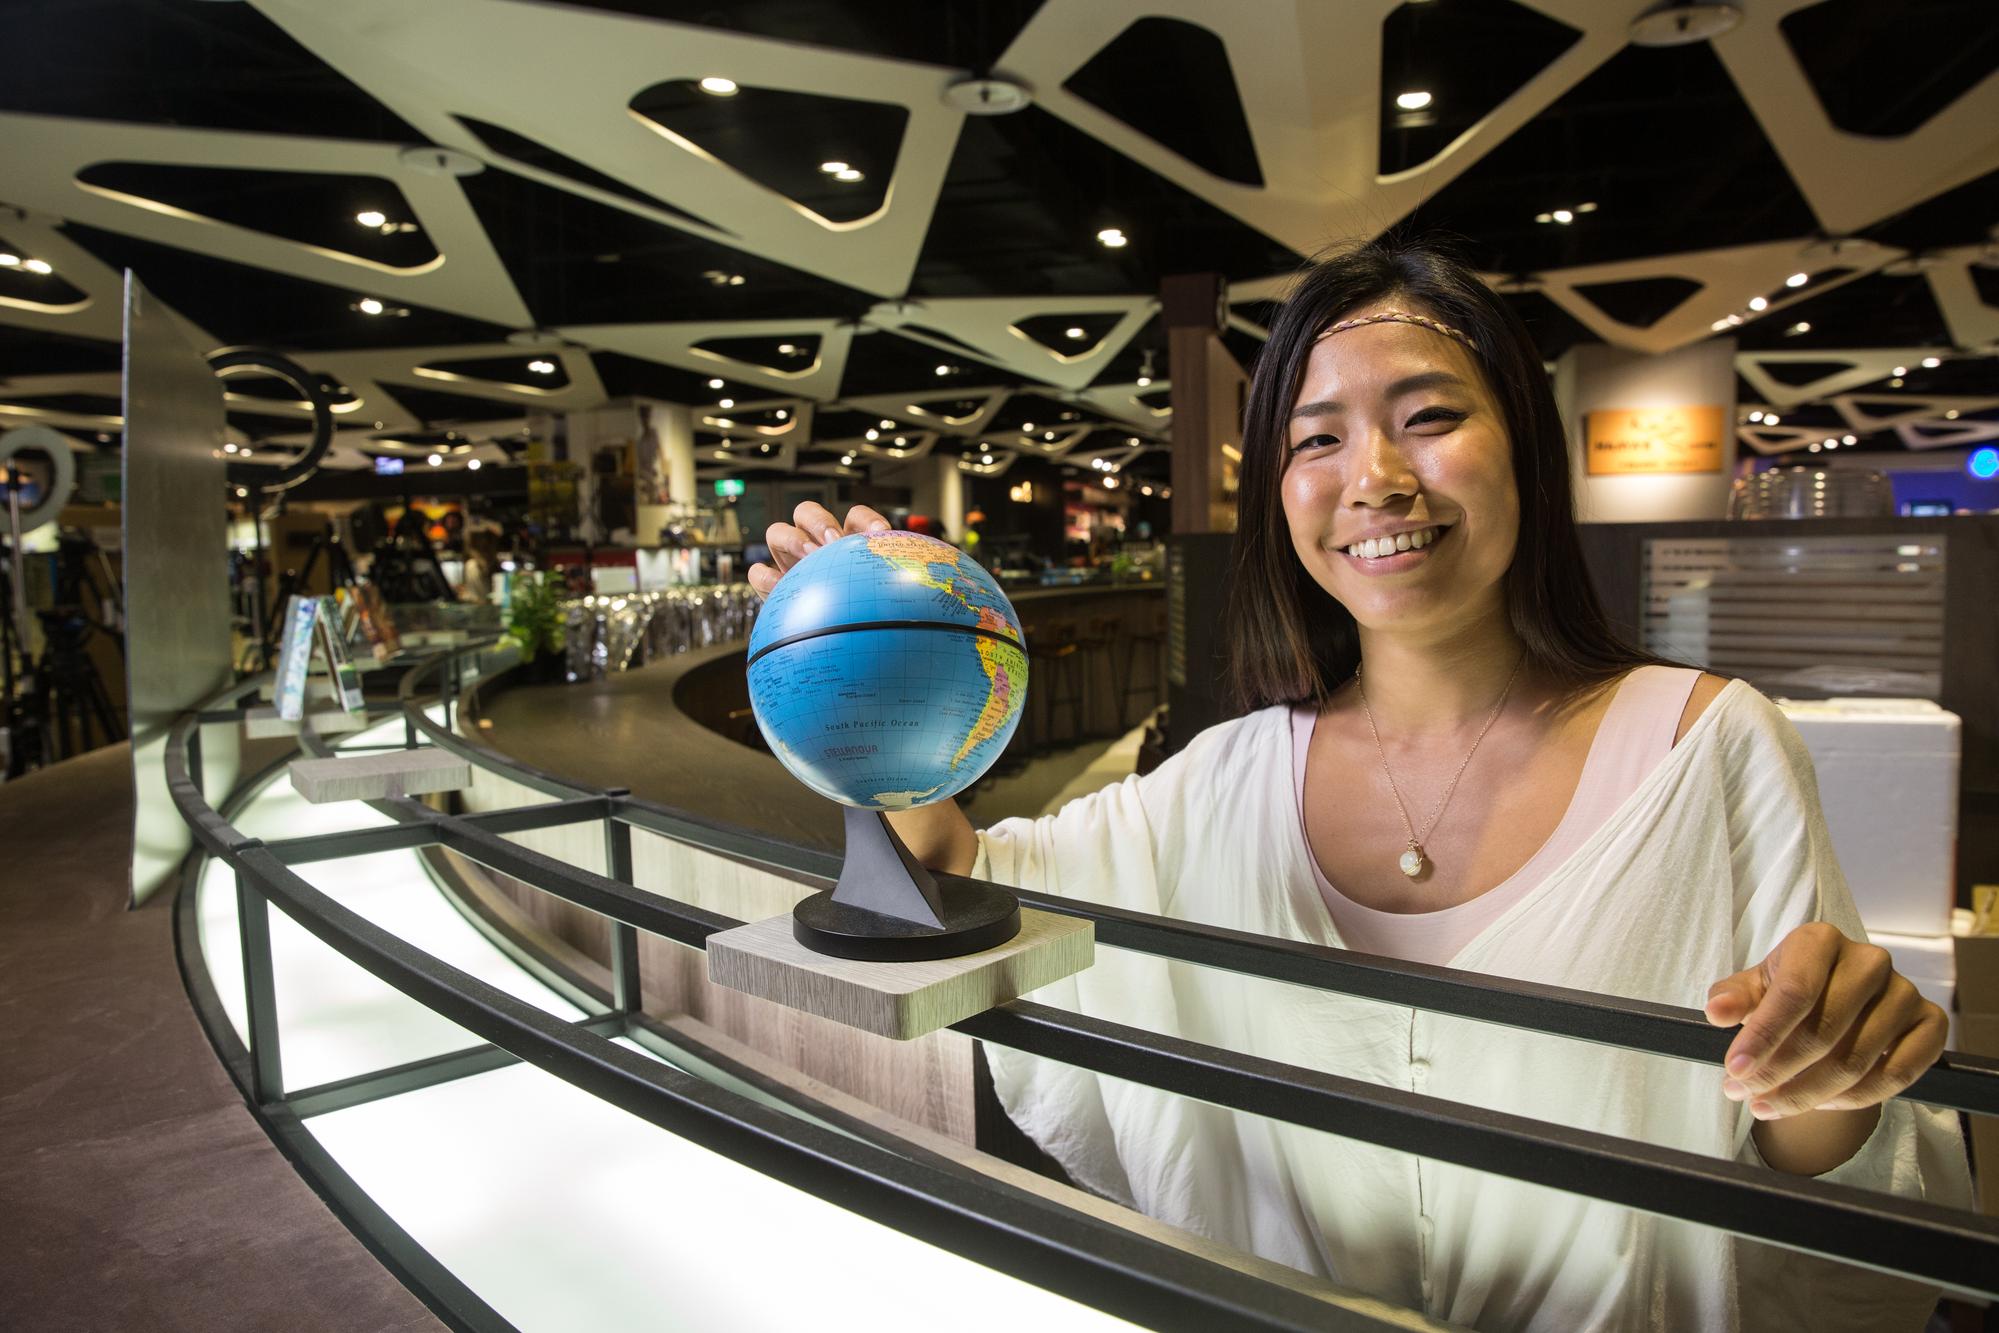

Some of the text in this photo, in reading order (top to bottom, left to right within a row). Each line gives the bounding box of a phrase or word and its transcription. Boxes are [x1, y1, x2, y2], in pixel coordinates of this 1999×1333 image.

[825, 719, 919, 732] South Pacific Ocean
